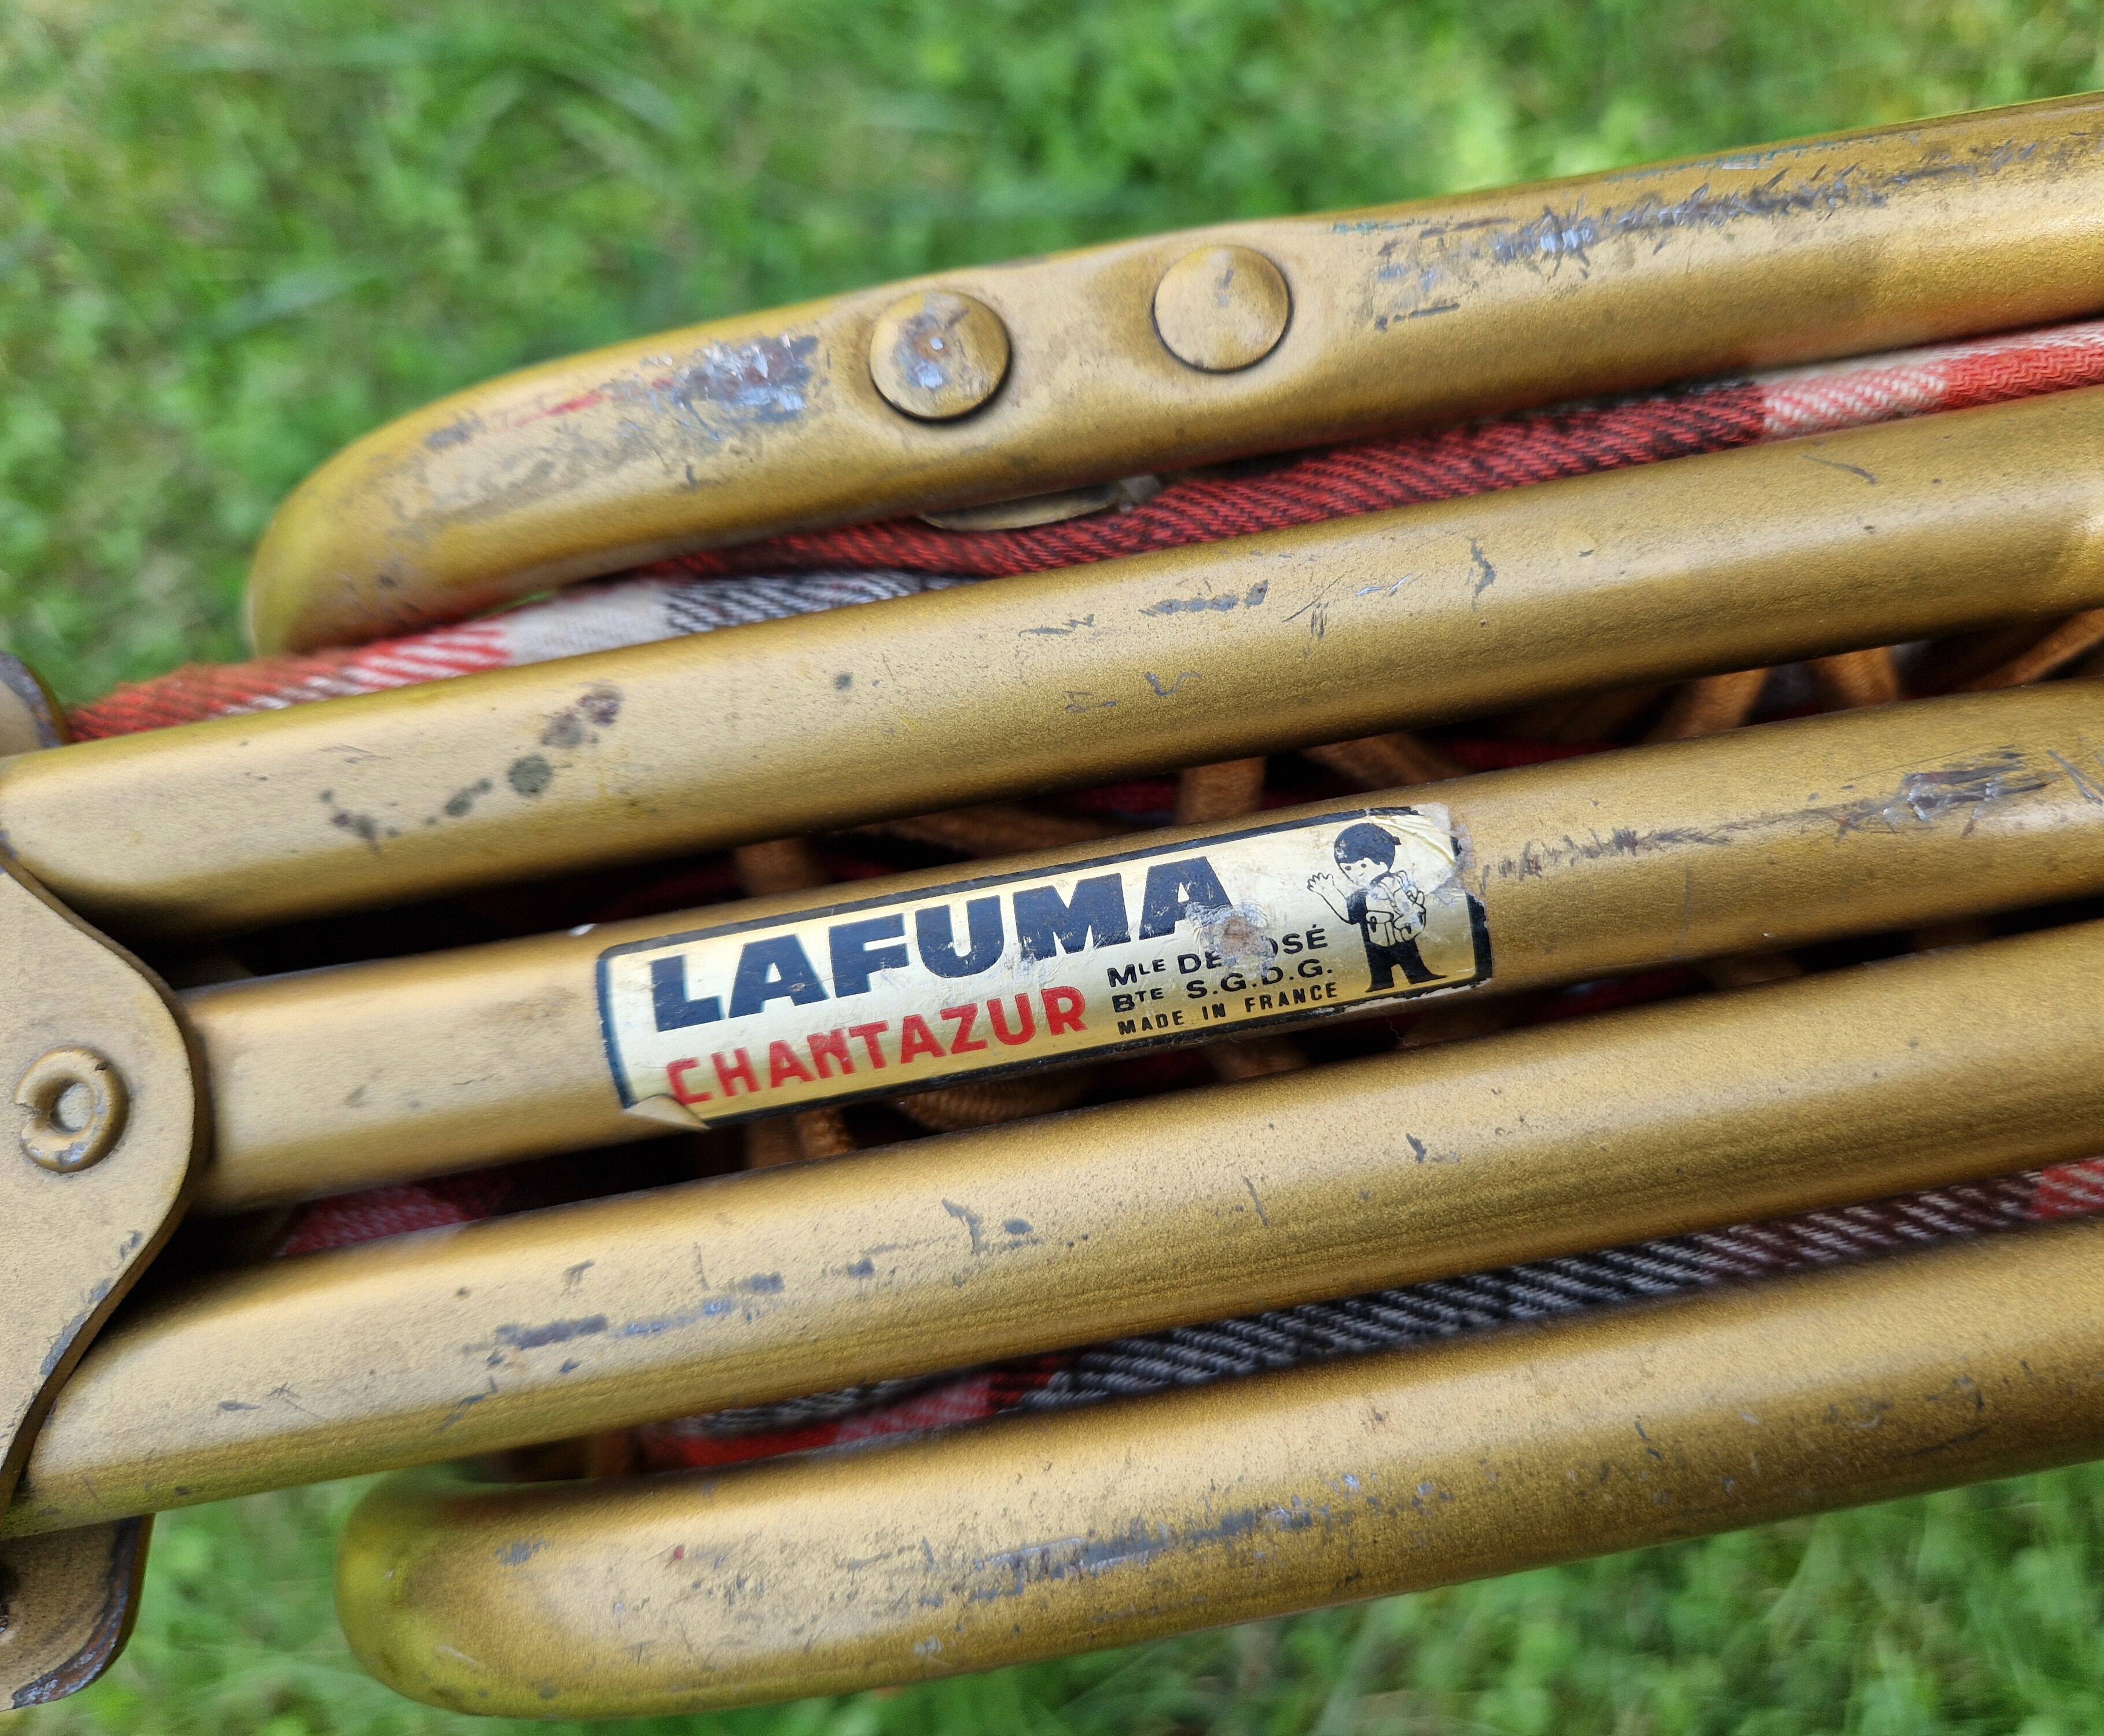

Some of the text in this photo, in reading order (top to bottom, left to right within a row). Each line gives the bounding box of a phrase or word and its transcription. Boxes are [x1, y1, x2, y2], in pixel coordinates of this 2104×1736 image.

[650, 856, 1235, 1032] LAFUMA
[1177, 924, 1328, 974] DESÉ
[1186, 958, 1333, 999] S.G.D.G.
[1117, 982, 1338, 1035] MADE IN FRANCE
[666, 986, 1088, 1105] CHANTAZUR
